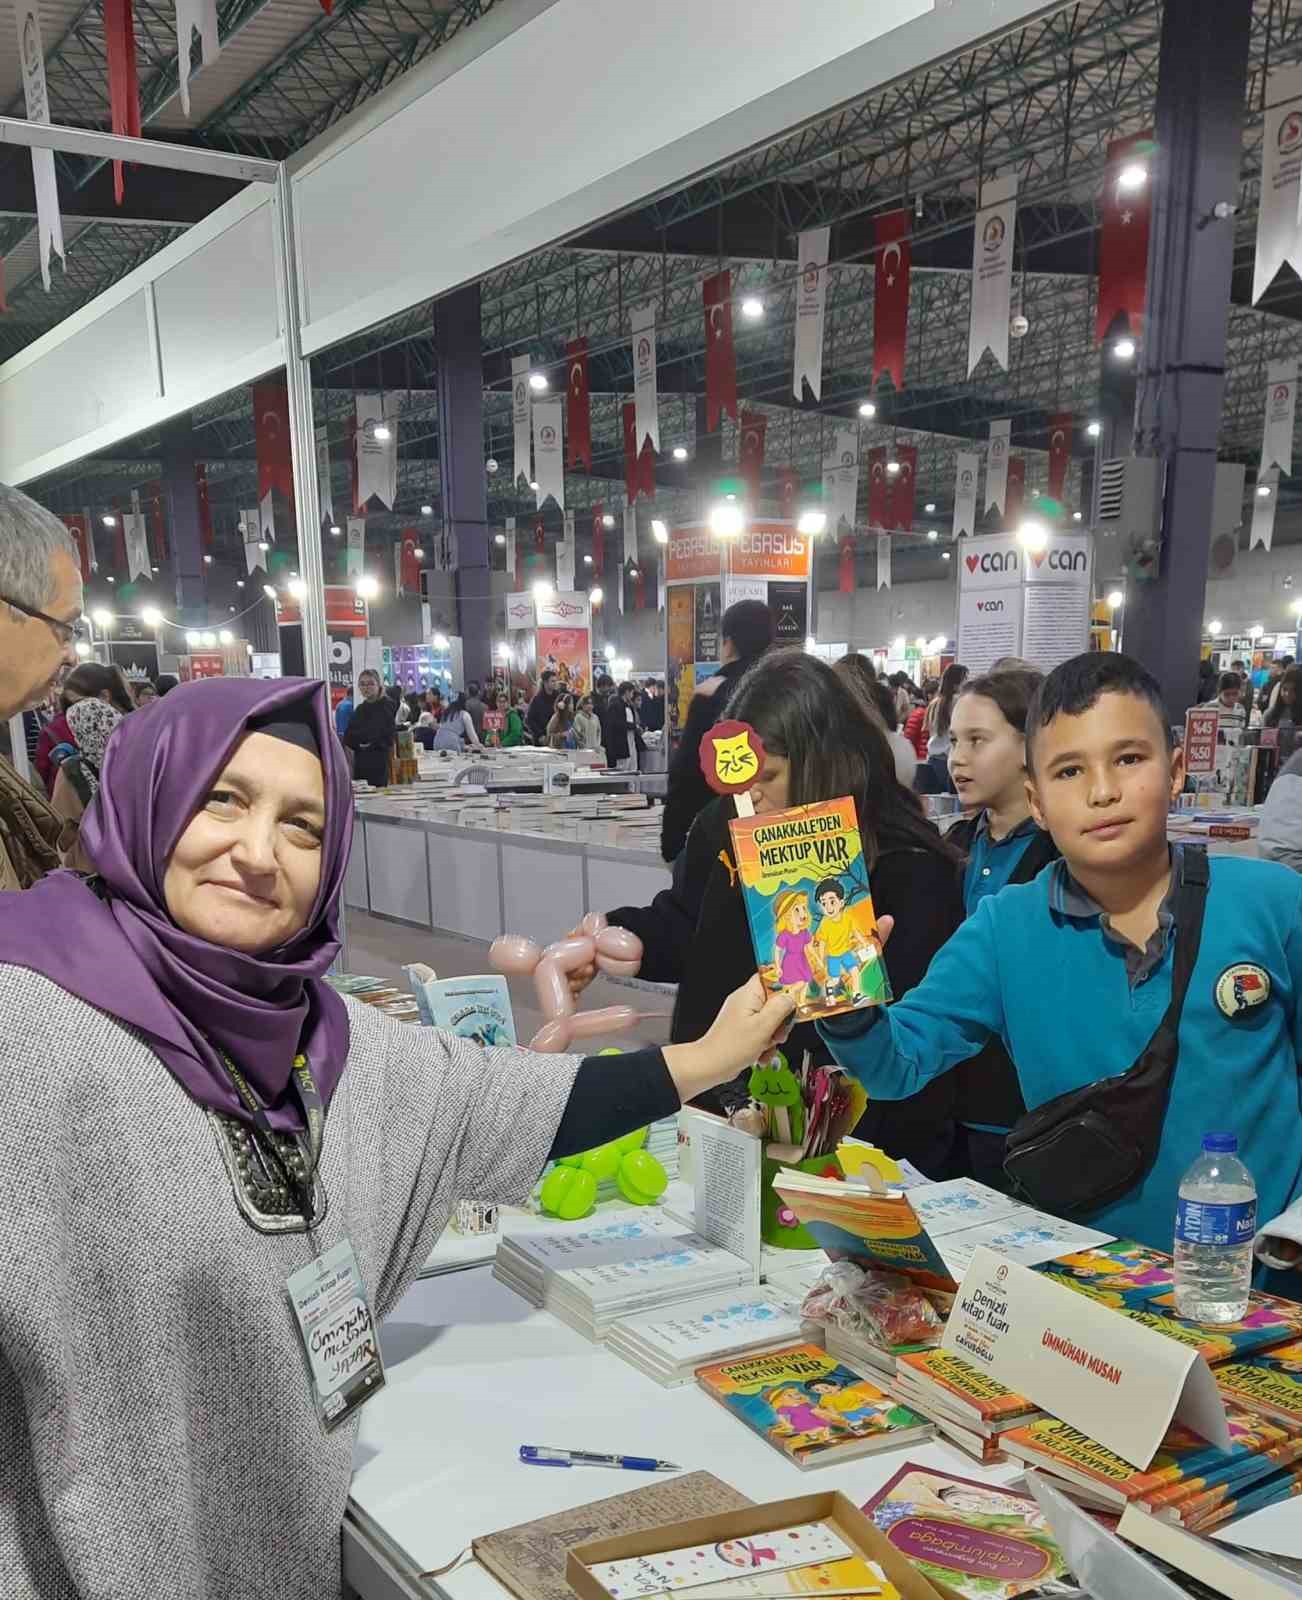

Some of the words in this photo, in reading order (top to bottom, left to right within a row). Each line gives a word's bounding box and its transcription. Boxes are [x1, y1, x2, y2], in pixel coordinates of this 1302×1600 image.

[742, 557, 793, 568] YAYINLARI
[980, 550, 1018, 573] can
[1048, 549, 1087, 571] can
[984, 600, 1004, 612] can
[1192, 721, 1213, 736] %45
[1190, 746, 1211, 760] %50
[754, 814, 841, 845] ÇANAKKALE'DEN
[760, 841, 812, 867] MEKTUP
[813, 836, 849, 864] VAR
[973, 1288, 1008, 1316] Denizli
[960, 1298, 985, 1323] kitap
[986, 1311, 1010, 1335] fuarı
[720, 1352, 809, 1376] ÇANAKKALE'DEN
[1041, 1327, 1088, 1366] ÜMMÜHAN
[1087, 1354, 1123, 1385] MUSAN
[731, 1367, 785, 1383] MEKTUP
[785, 1359, 830, 1375] VAR
